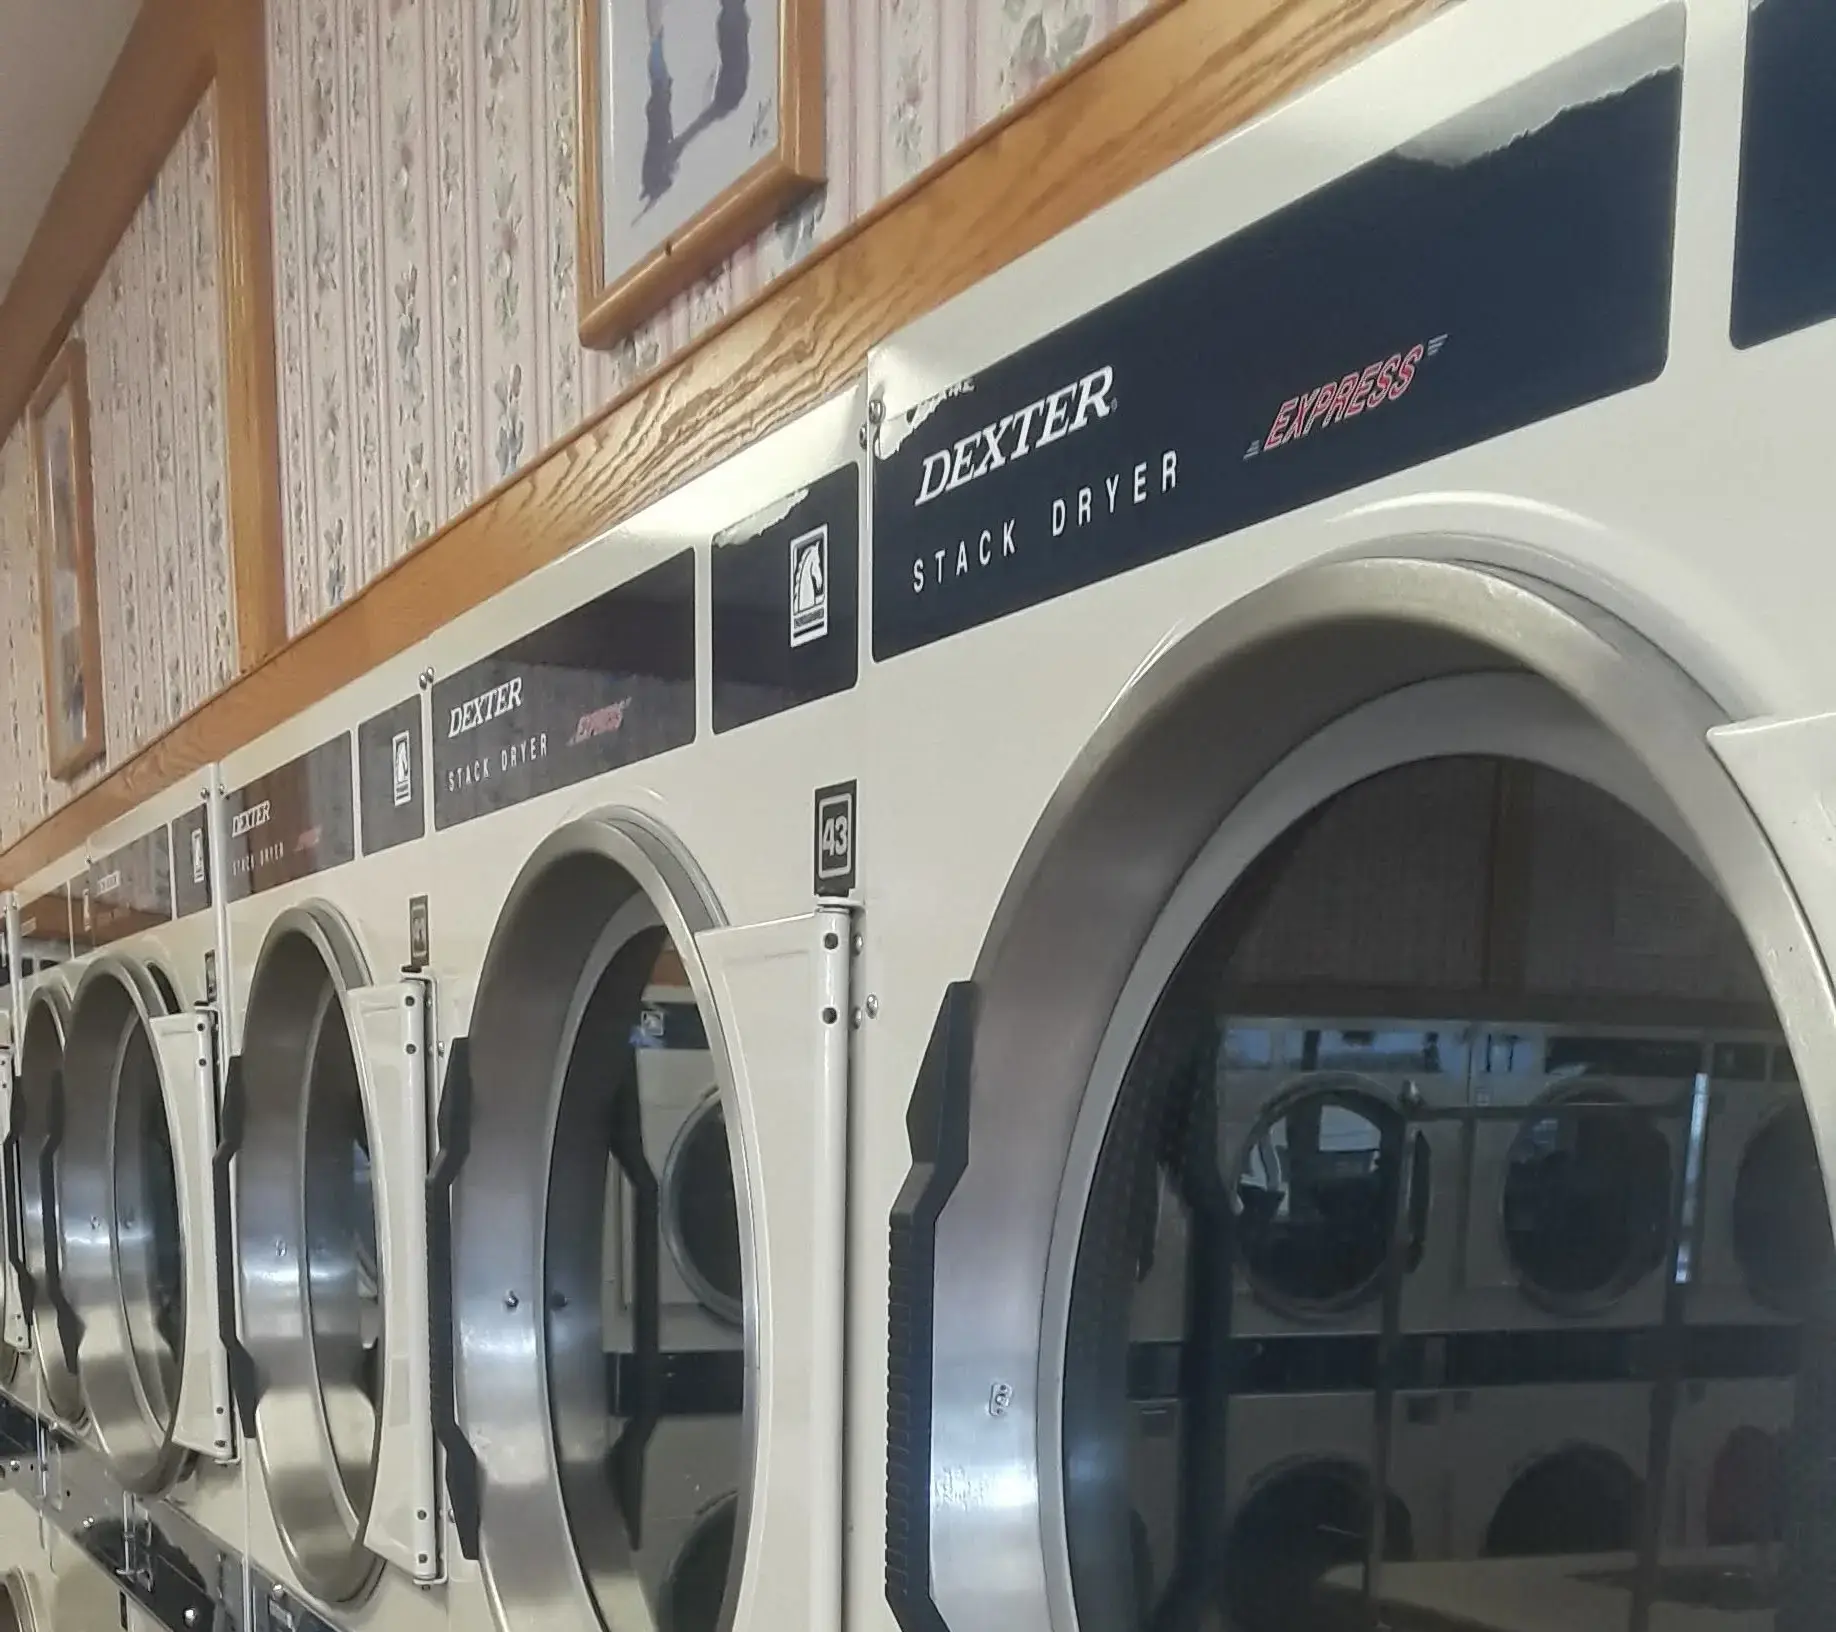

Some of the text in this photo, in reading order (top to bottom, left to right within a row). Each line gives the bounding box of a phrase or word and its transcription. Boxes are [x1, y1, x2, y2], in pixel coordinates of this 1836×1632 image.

[915, 365, 1114, 506] DEXTER
[1263, 343, 1425, 450] EXPRESS
[912, 450, 1179, 594] STACK DRYER
[448, 677, 523, 738] DEXTER
[448, 733, 548, 792] STACK DRYER
[821, 815, 849, 857] 43
